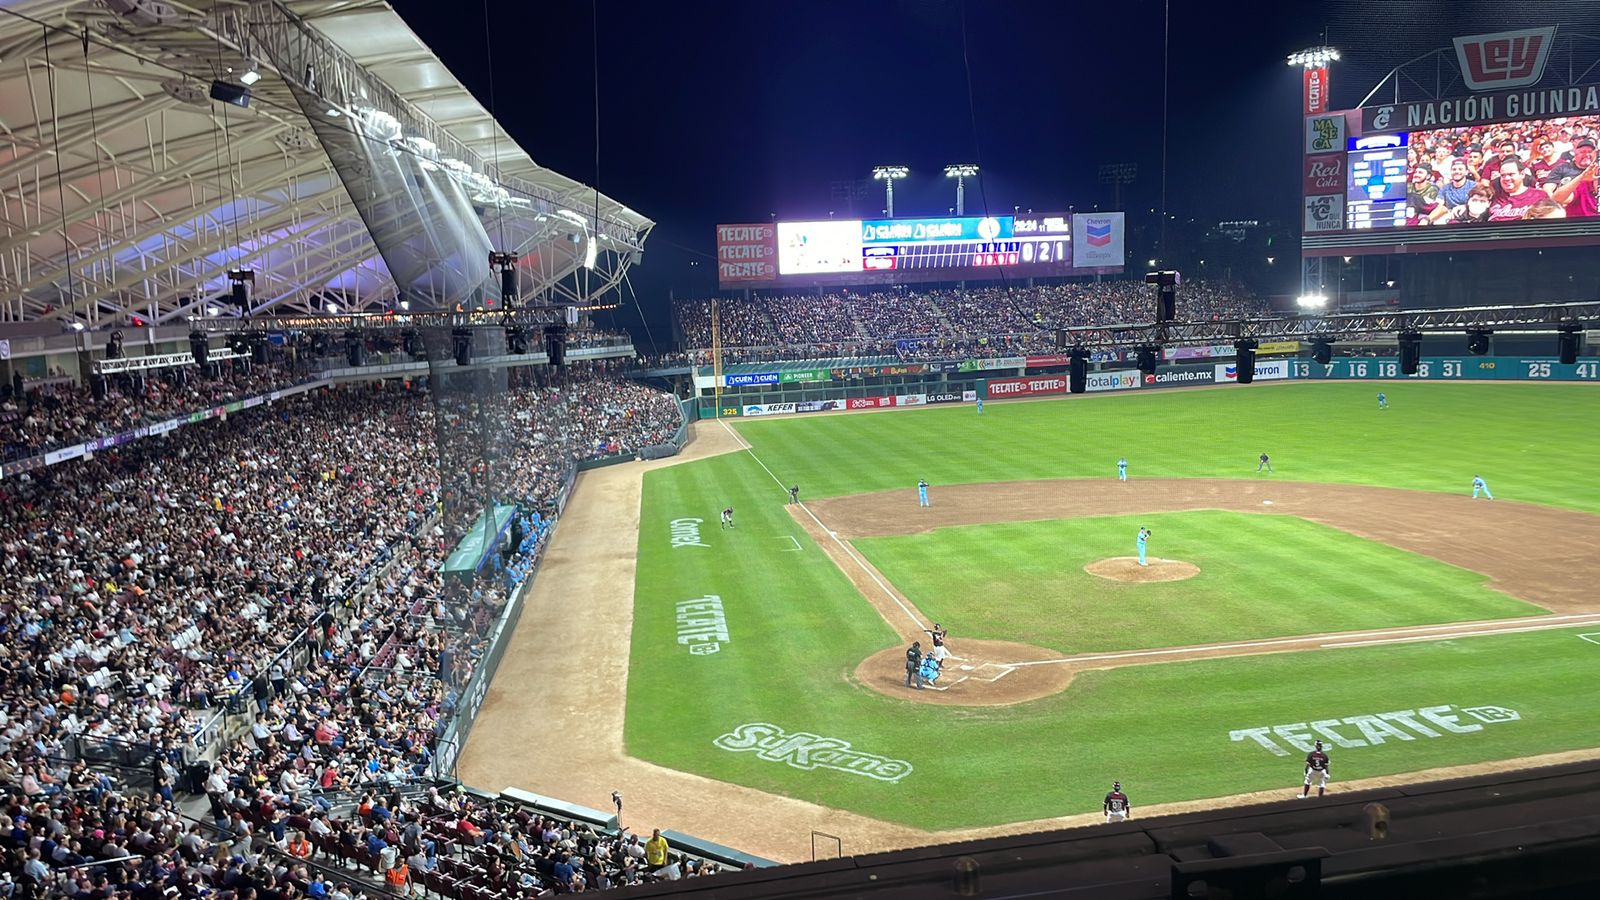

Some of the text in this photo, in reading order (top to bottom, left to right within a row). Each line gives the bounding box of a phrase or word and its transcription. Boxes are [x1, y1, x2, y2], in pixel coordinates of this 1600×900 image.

[1309, 78, 1319, 112] TECATE
[1407, 86, 1599, 127] NACIÓN GUINDA
[1307, 160, 1341, 178] Red
[1315, 177, 1338, 188] Cola
[1316, 220, 1341, 230] NUNCA
[719, 227, 764, 241] TECATE
[720, 245, 765, 259] TECATE
[1039, 242, 1050, 260] 2
[1056, 242, 1063, 260] 1
[720, 262, 765, 277] TECATE
[1155, 371, 1212, 383] caliente.mx
[1254, 366, 1280, 376] evron
[1294, 364, 1310, 377] 13
[1324, 364, 1334, 377] 7
[1349, 364, 1367, 377] 16
[1379, 364, 1397, 377] 18
[1443, 363, 1462, 377] 31
[1528, 363, 1551, 377] 25
[1576, 364, 1597, 378] 41
[990, 379, 1059, 394] TECATE TECATE
[1086, 374, 1136, 388] Totalplay
[723, 408, 737, 416] 325
[767, 403, 794, 412] KEFER
[675, 594, 730, 644] TECATE
[1228, 704, 1484, 757] TECATE
